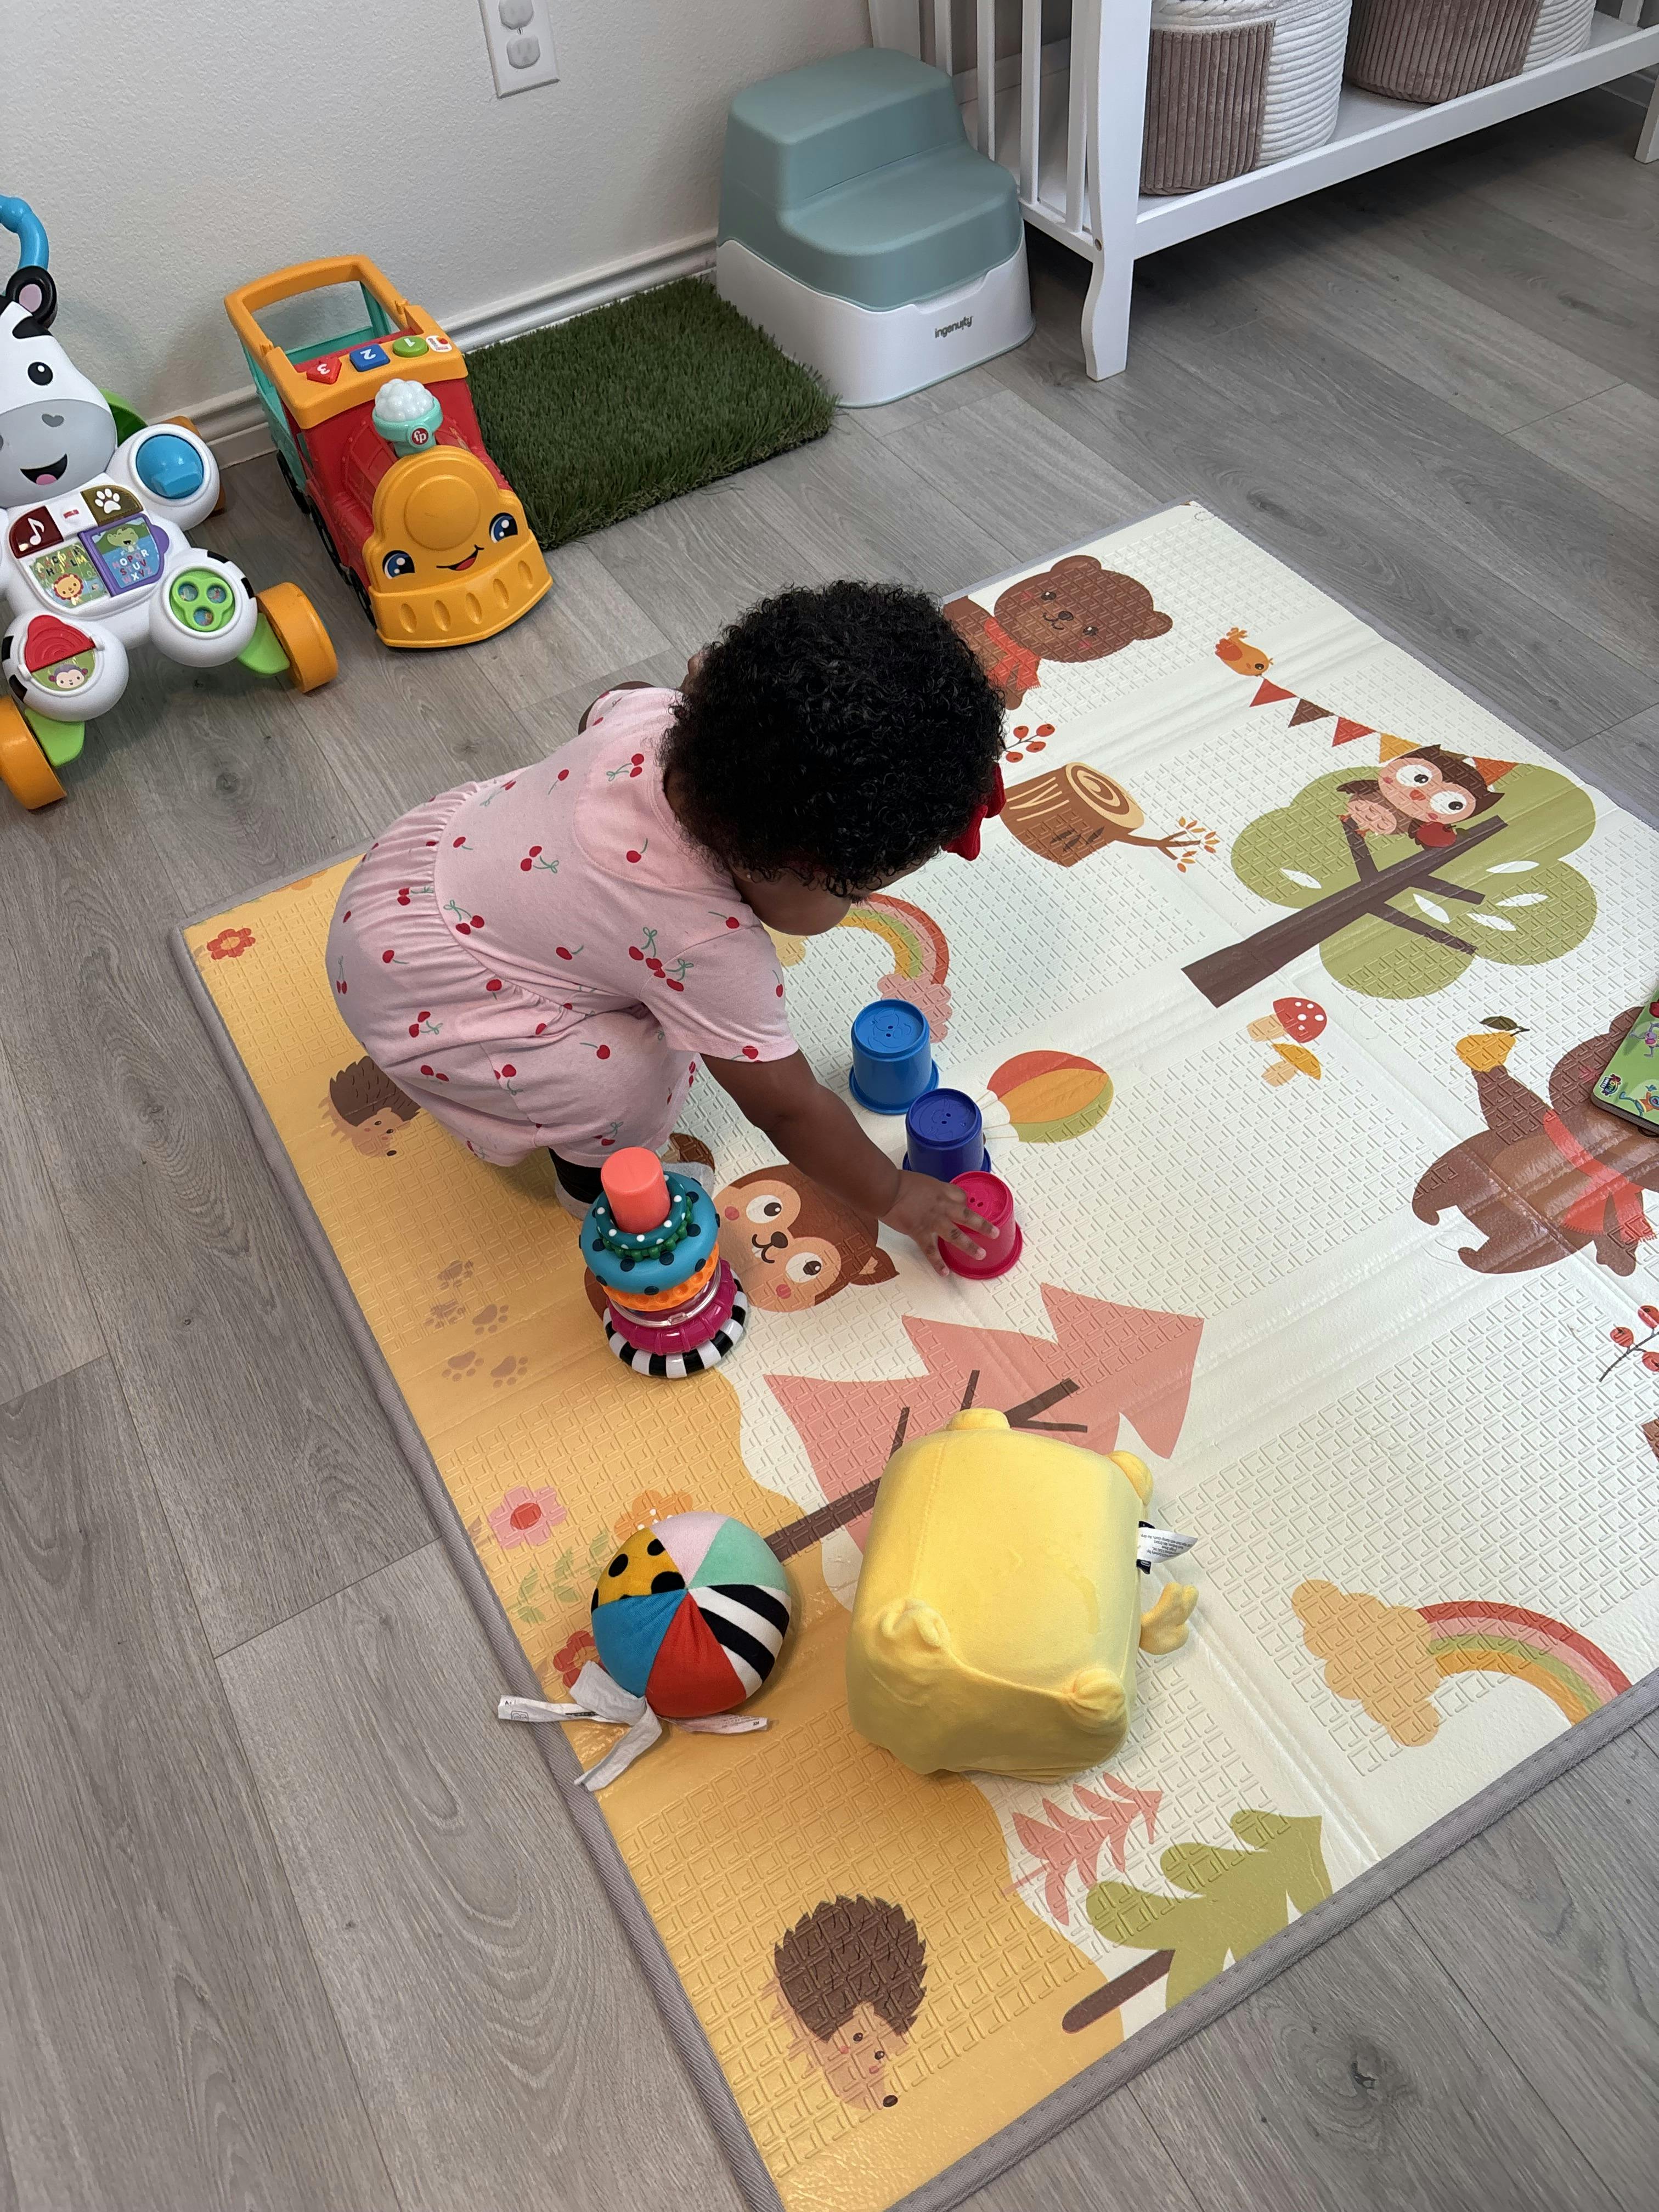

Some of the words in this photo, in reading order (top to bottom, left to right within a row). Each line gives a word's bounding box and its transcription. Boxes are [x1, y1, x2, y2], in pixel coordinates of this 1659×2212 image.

[934, 315, 973, 338] ingenuity
[404, 337, 415, 347] 1
[359, 348, 376, 360] 2
[317, 363, 330, 375] 3
[414, 430, 427, 444] fp
